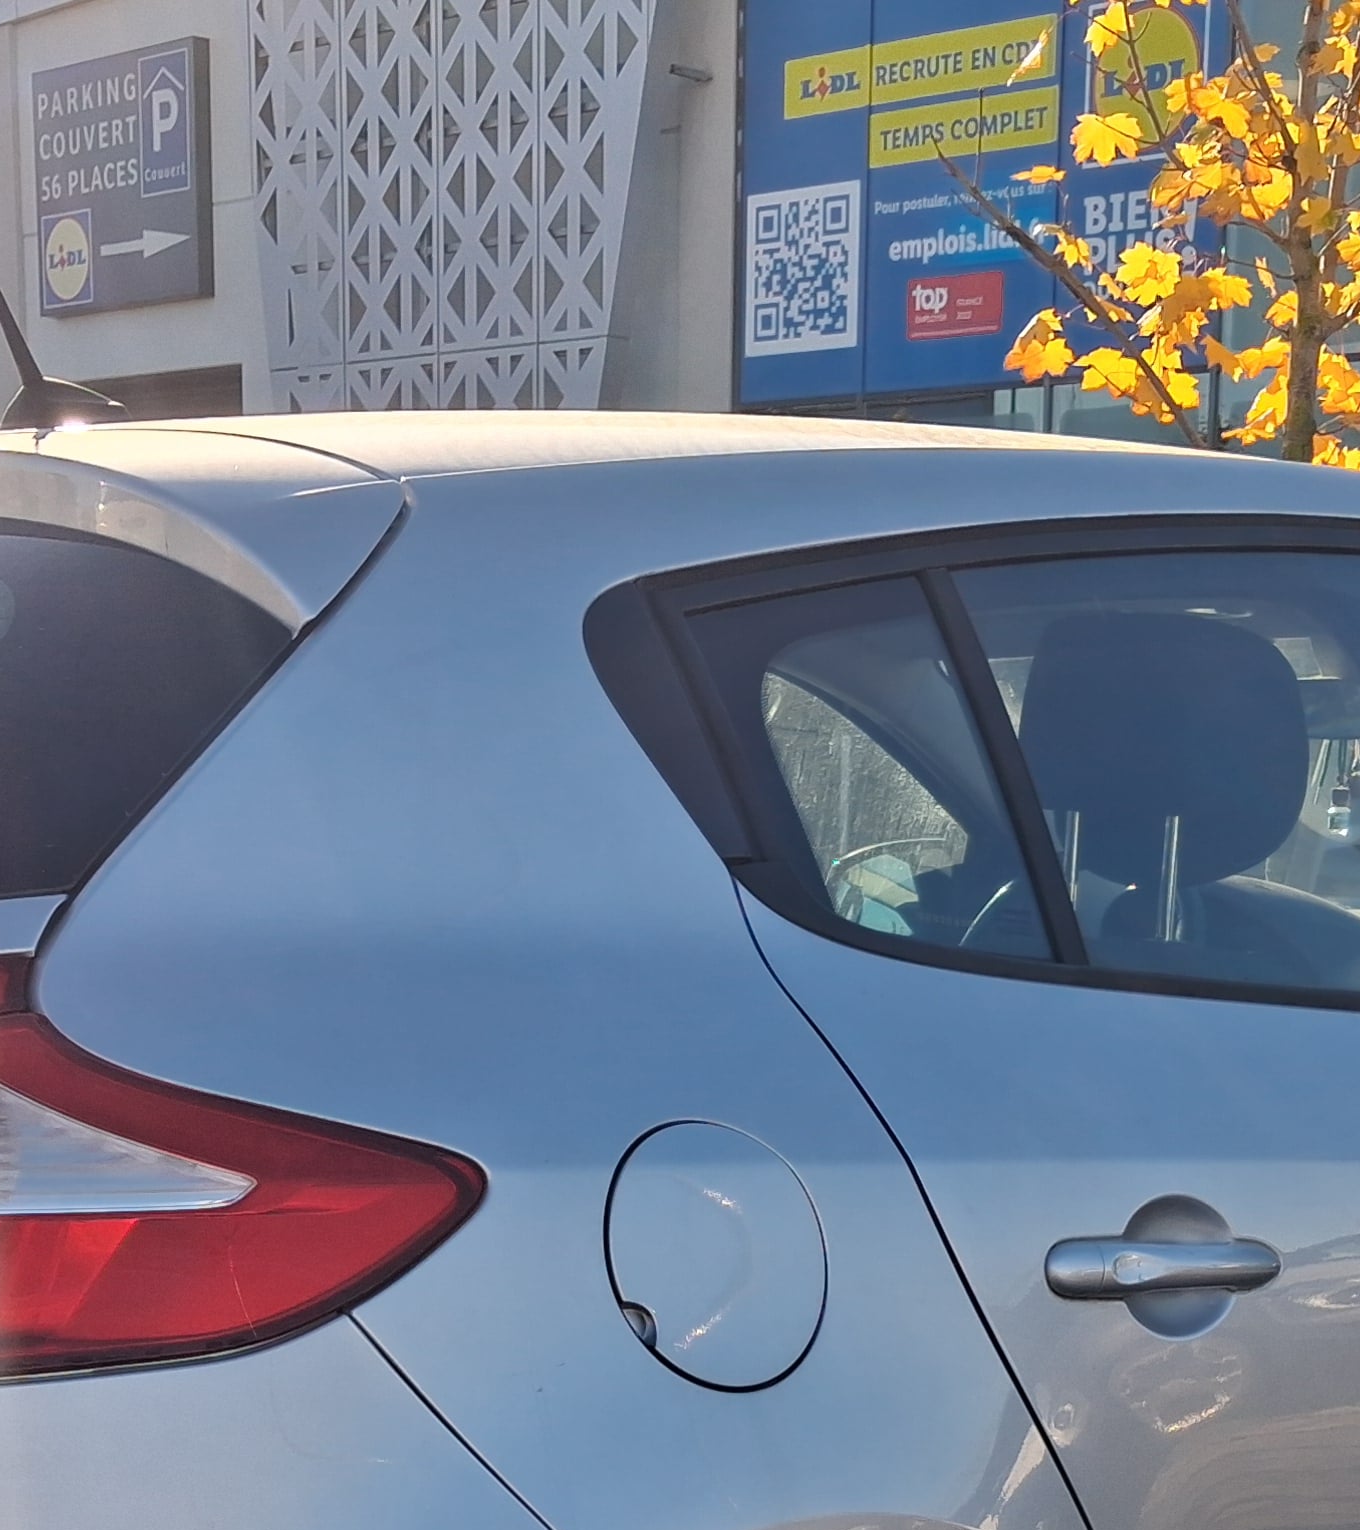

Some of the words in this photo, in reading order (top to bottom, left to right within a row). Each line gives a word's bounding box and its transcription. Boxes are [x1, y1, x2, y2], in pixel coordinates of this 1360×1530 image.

[875, 52, 963, 86] RECRUTE
[971, 46, 996, 70] EN
[1002, 40, 1041, 65] CD
[37, 73, 137, 121] PARKING
[151, 87, 179, 152] P
[39, 114, 138, 161] COUVERT
[880, 123, 944, 152] TEMPS
[950, 106, 1048, 140] COMPLET
[41, 174, 62, 201] 56
[68, 158, 138, 196] PLACES
[144, 161, 186, 182] Couvert
[874, 199, 900, 215] Pour
[912, 284, 949, 315] top
